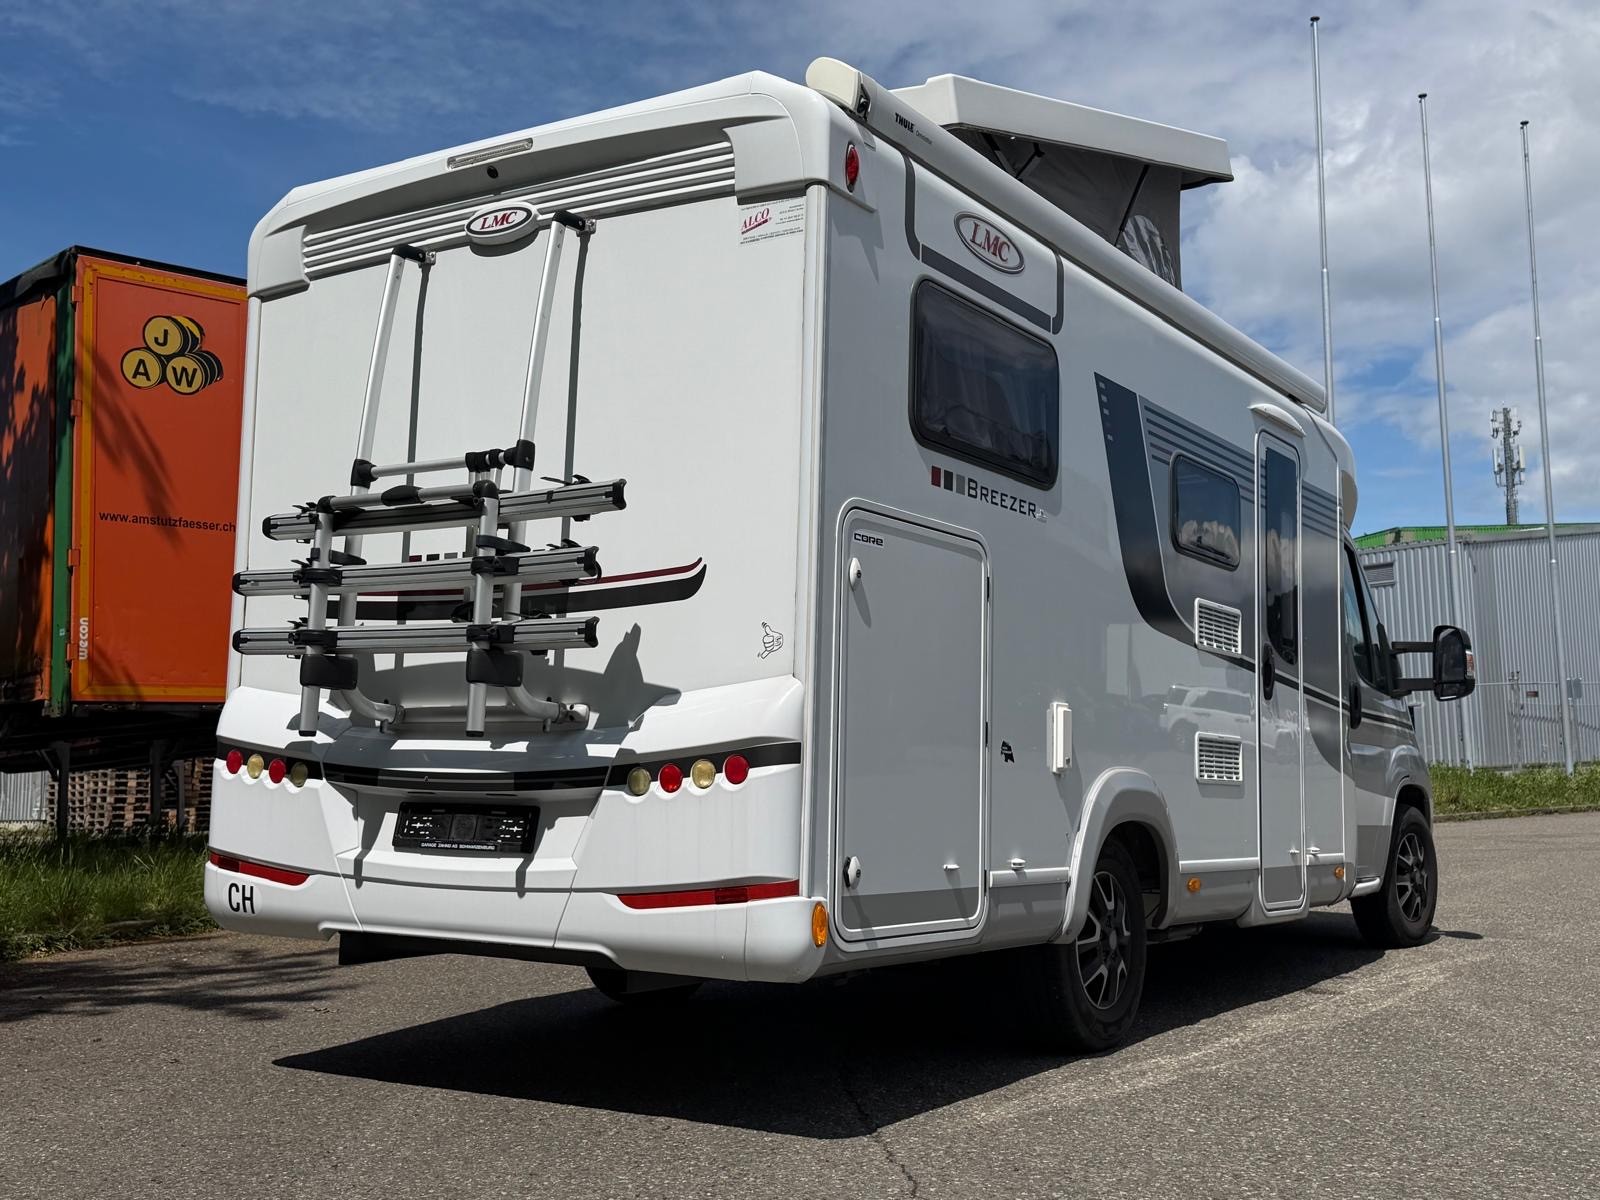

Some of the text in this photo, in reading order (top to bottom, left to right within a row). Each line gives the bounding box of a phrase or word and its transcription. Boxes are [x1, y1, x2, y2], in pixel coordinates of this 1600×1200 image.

[895, 112, 914, 133] THULE
[480, 211, 518, 230] LMC
[741, 207, 770, 231] ALCO
[970, 221, 1010, 262] LMC
[153, 328, 169, 347] J
[131, 358, 198, 388] A W
[967, 477, 1037, 519] BREEZER
[99, 511, 236, 532] www.amstutzfaesser.ch
[79, 617, 89, 660] wecon
[228, 883, 256, 914] CH
